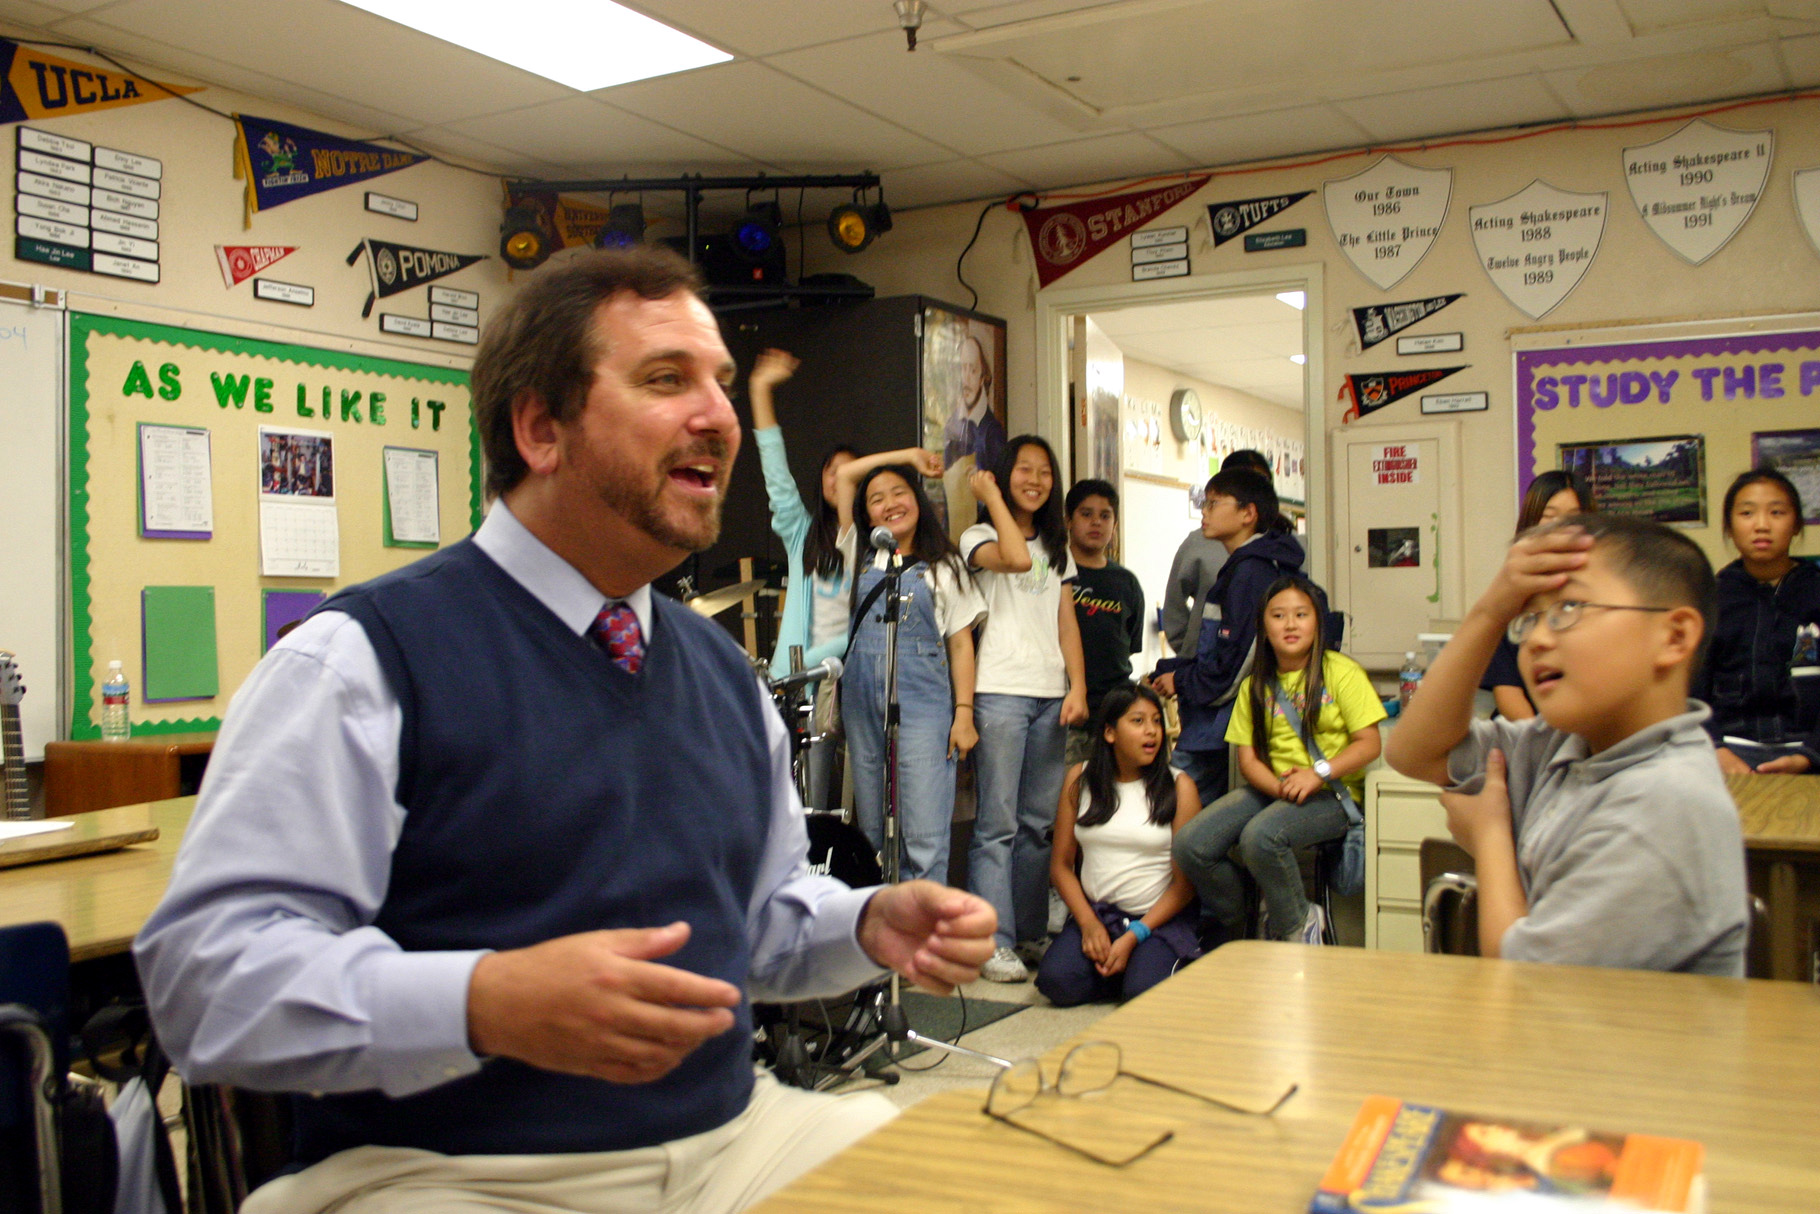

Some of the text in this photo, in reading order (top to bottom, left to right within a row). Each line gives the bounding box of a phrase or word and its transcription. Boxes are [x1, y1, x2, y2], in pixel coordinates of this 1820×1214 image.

[28, 61, 140, 110] UCLA
[311, 149, 381, 179] NOTRE
[1628, 161, 1667, 176] Acting
[1673, 149, 1750, 170] Shakespeare
[1680, 169, 1713, 186] 1990
[1354, 186, 1420, 203] Our Town
[1087, 182, 1194, 241] STANFORD
[1239, 196, 1289, 228] TUFTS
[1373, 201, 1401, 217] 1986
[1474, 206, 1600, 231] Acting Shakespeare
[1652, 201, 1696, 216] Midsummer
[1684, 212, 1712, 229] 1991
[1340, 225, 1441, 248] The Little Prince
[1521, 226, 1551, 242] 1988
[250, 247, 285, 271] CHAPMAN
[1375, 244, 1402, 260] 1987
[1487, 247, 1589, 270] Twelve Angry People
[399, 250, 460, 281] POMONA
[1524, 270, 1554, 286] 1989
[122, 360, 446, 431] AS WE LIKE IT
[1534, 370, 1679, 410] STUDY
[1692, 363, 1785, 401] THE
[1384, 446, 1406, 458] FIRE
[1378, 471, 1413, 484] INSIDE
[1073, 586, 1122, 616] Vegas
